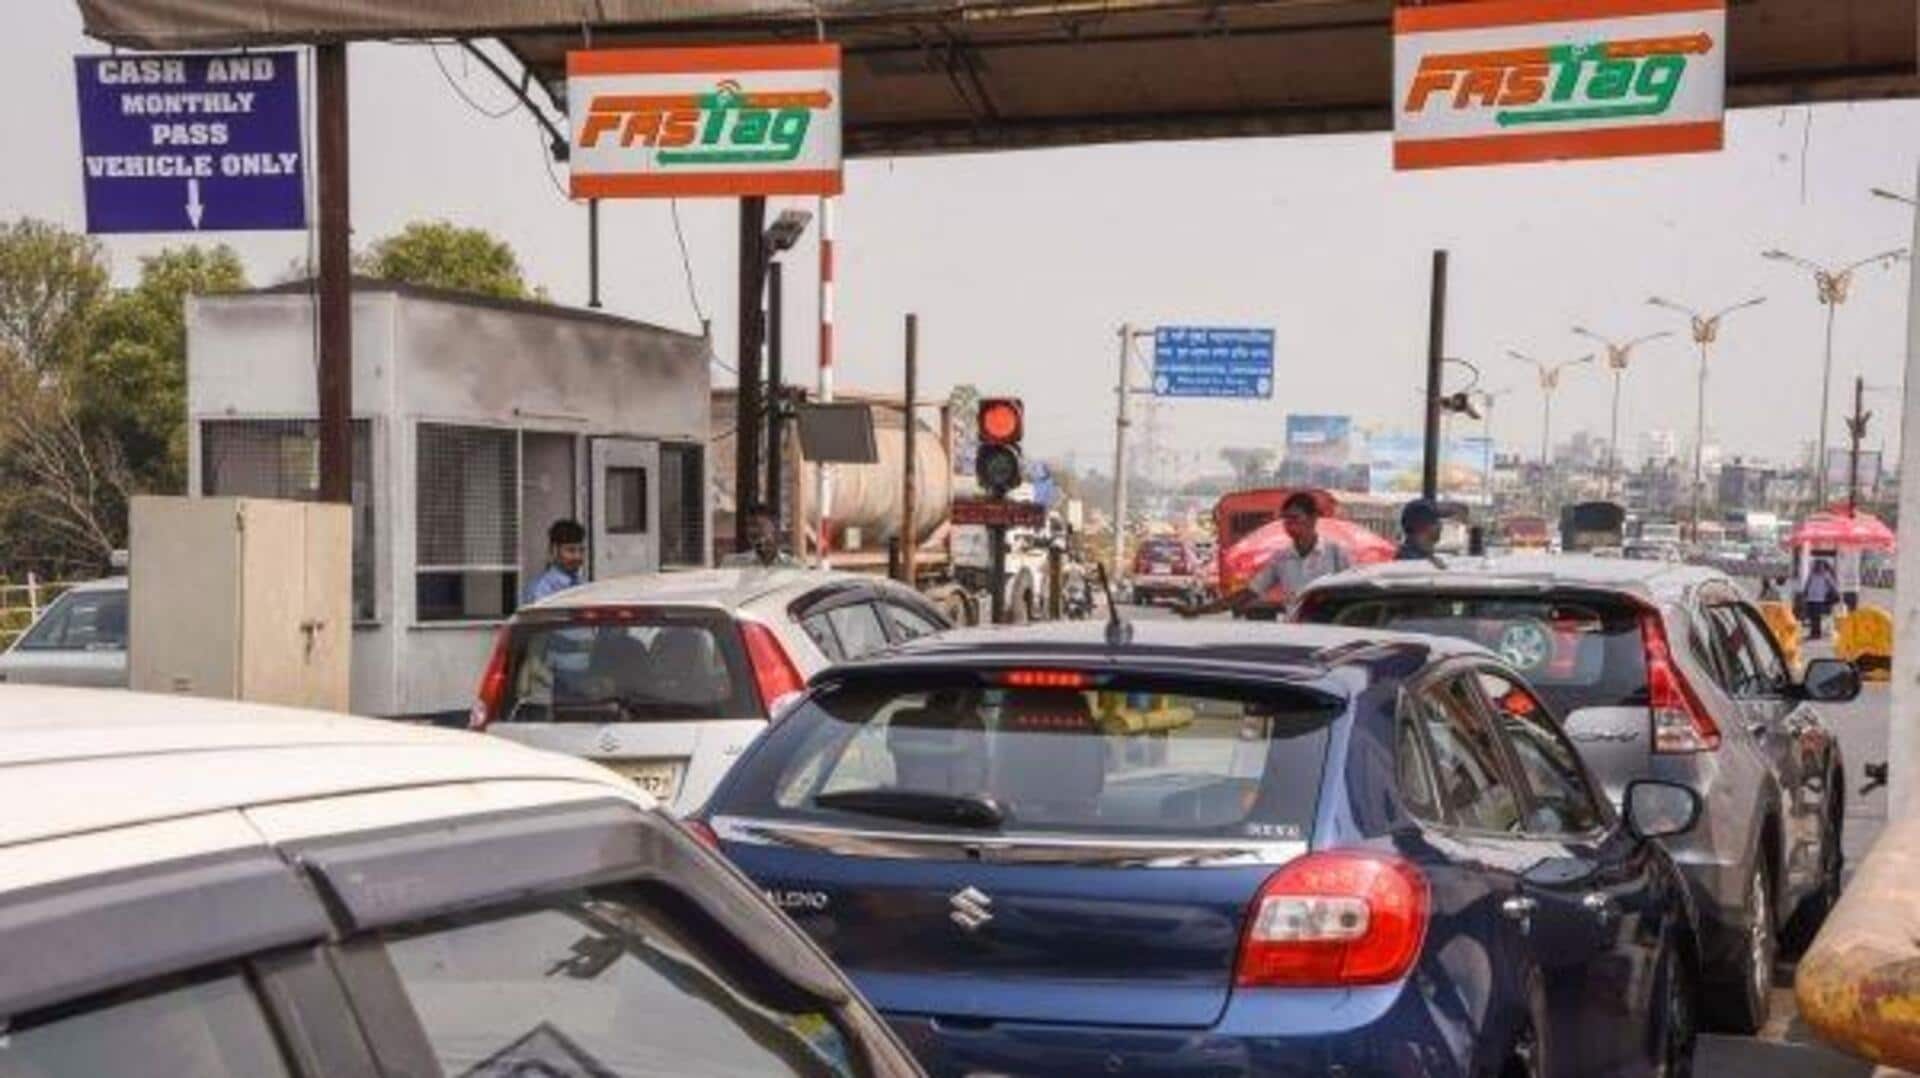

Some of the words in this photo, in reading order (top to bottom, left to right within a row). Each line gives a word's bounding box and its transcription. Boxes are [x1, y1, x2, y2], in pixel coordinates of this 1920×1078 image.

[98, 58, 186, 84] CASH
[206, 56, 275, 82] AND
[1404, 32, 1713, 128] FASTag
[120, 91, 255, 116] MONTHLY
[152, 122, 229, 146] PASS
[578, 88, 833, 166] FASTag
[86, 155, 213, 178] VEHICLE
[219, 152, 298, 176] ONLY
